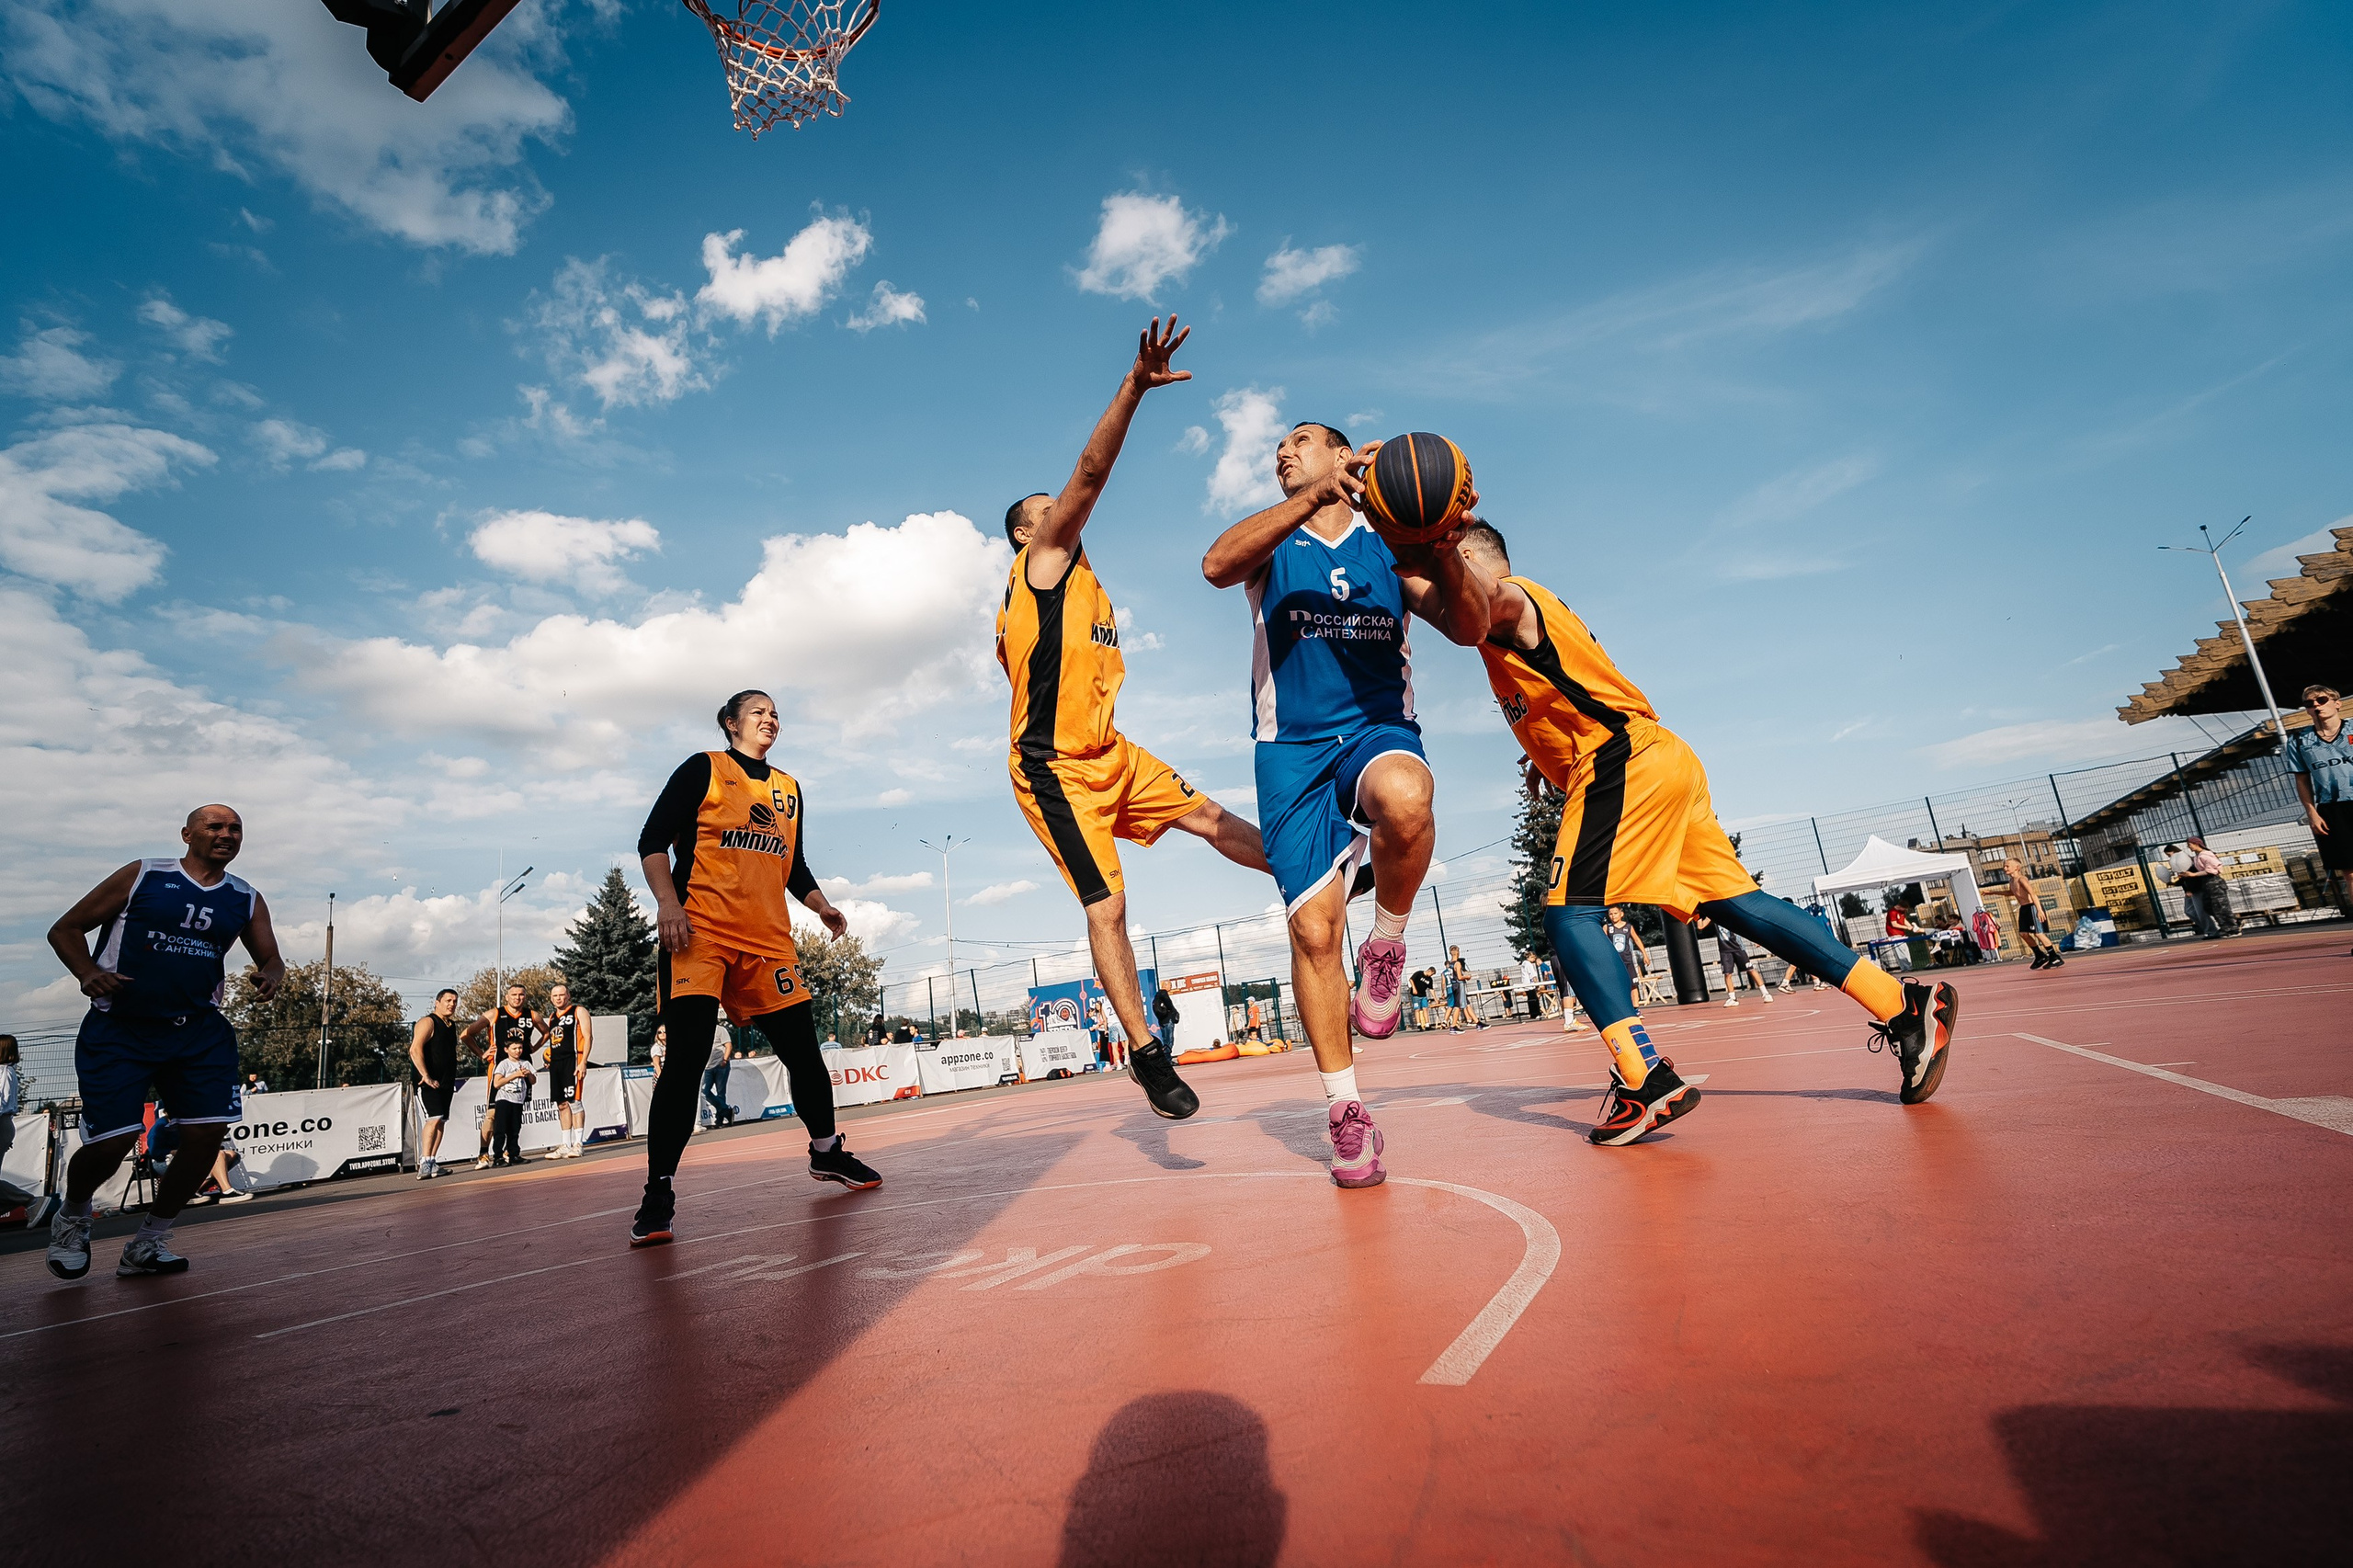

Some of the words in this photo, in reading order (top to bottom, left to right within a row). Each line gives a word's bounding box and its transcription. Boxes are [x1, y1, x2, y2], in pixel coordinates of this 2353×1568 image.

[1330, 566, 1350, 602] 5
[1300, 625, 1392, 642] САНТЕХНИКА
[771, 788, 798, 821] 69
[179, 903, 214, 931] 15
[517, 1017, 534, 1028] 55
[559, 1015, 574, 1027] 25
[940, 1051, 994, 1066] appzone.co
[845, 1064, 890, 1085] DKC
[535, 1109, 561, 1123] БАСКЕТ
[250, 1138, 313, 1155] техники
